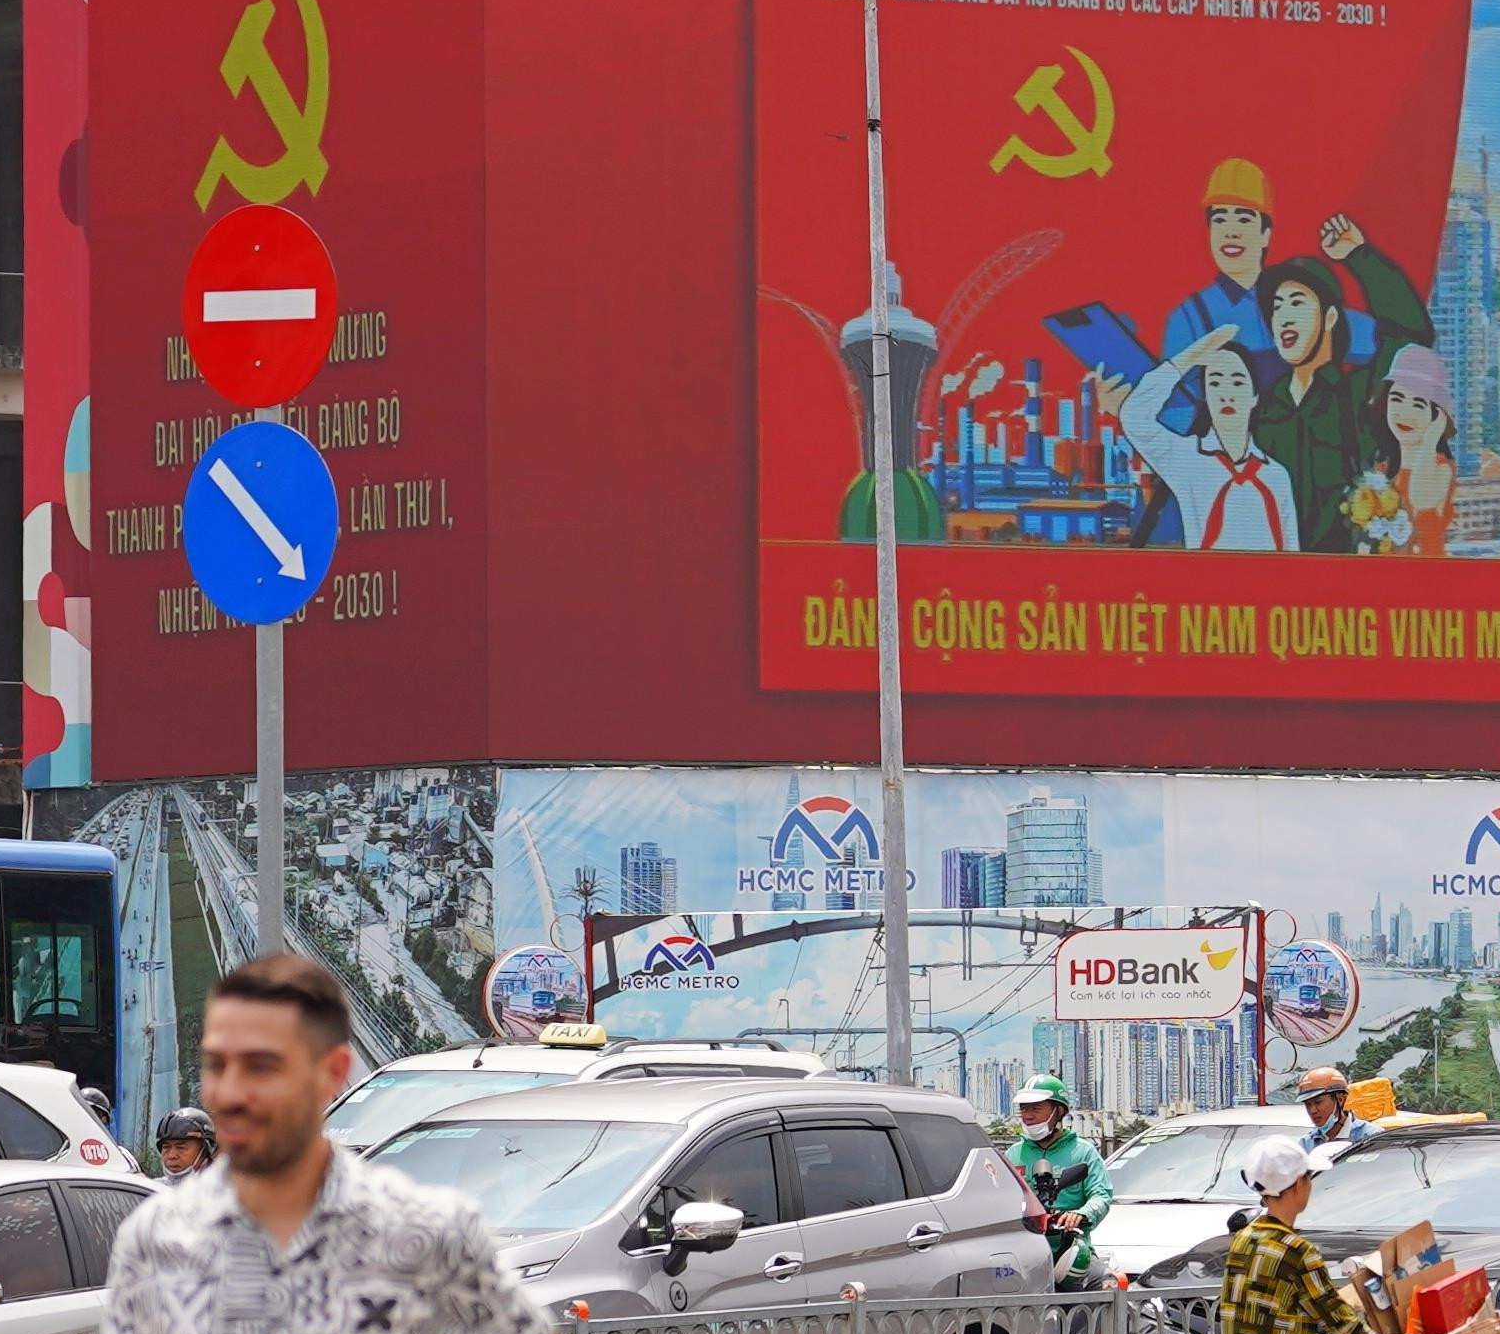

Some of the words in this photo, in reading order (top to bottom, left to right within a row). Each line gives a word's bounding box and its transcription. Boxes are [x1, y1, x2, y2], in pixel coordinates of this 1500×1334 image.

[1284, 1, 1321, 22] 2025
[1337, 3, 1373, 25] 2030
[1380, 5, 1386, 27] !
[329, 308, 386, 363] MỪNG
[156, 420, 184, 471] ĐẠI
[318, 394, 368, 449] ĐẢNG
[377, 389, 400, 449] BỘ
[106, 502, 165, 554] THÀNH
[350, 473, 385, 532] LẦN
[394, 472, 432, 529] THỨ
[441, 478, 453, 530] I,
[334, 570, 383, 620] 2030
[392, 570, 397, 615] !
[804, 583, 880, 650] ĐẢN
[911, 588, 1006, 664] CỘNG
[1017, 583, 1086, 653] SẢN
[1099, 595, 1164, 664] VIỆT
[1178, 602, 1256, 655] NAM
[1268, 603, 1377, 661] QUANG
[1389, 608, 1463, 659] VINH
[739, 869, 814, 892] HCMC
[620, 976, 672, 990] HCMC
[678, 975, 740, 990] METRO
[1070, 958, 1200, 985] HDBank
[1070, 991, 1093, 1001] Cam
[547, 1023, 593, 1038] TAXI
